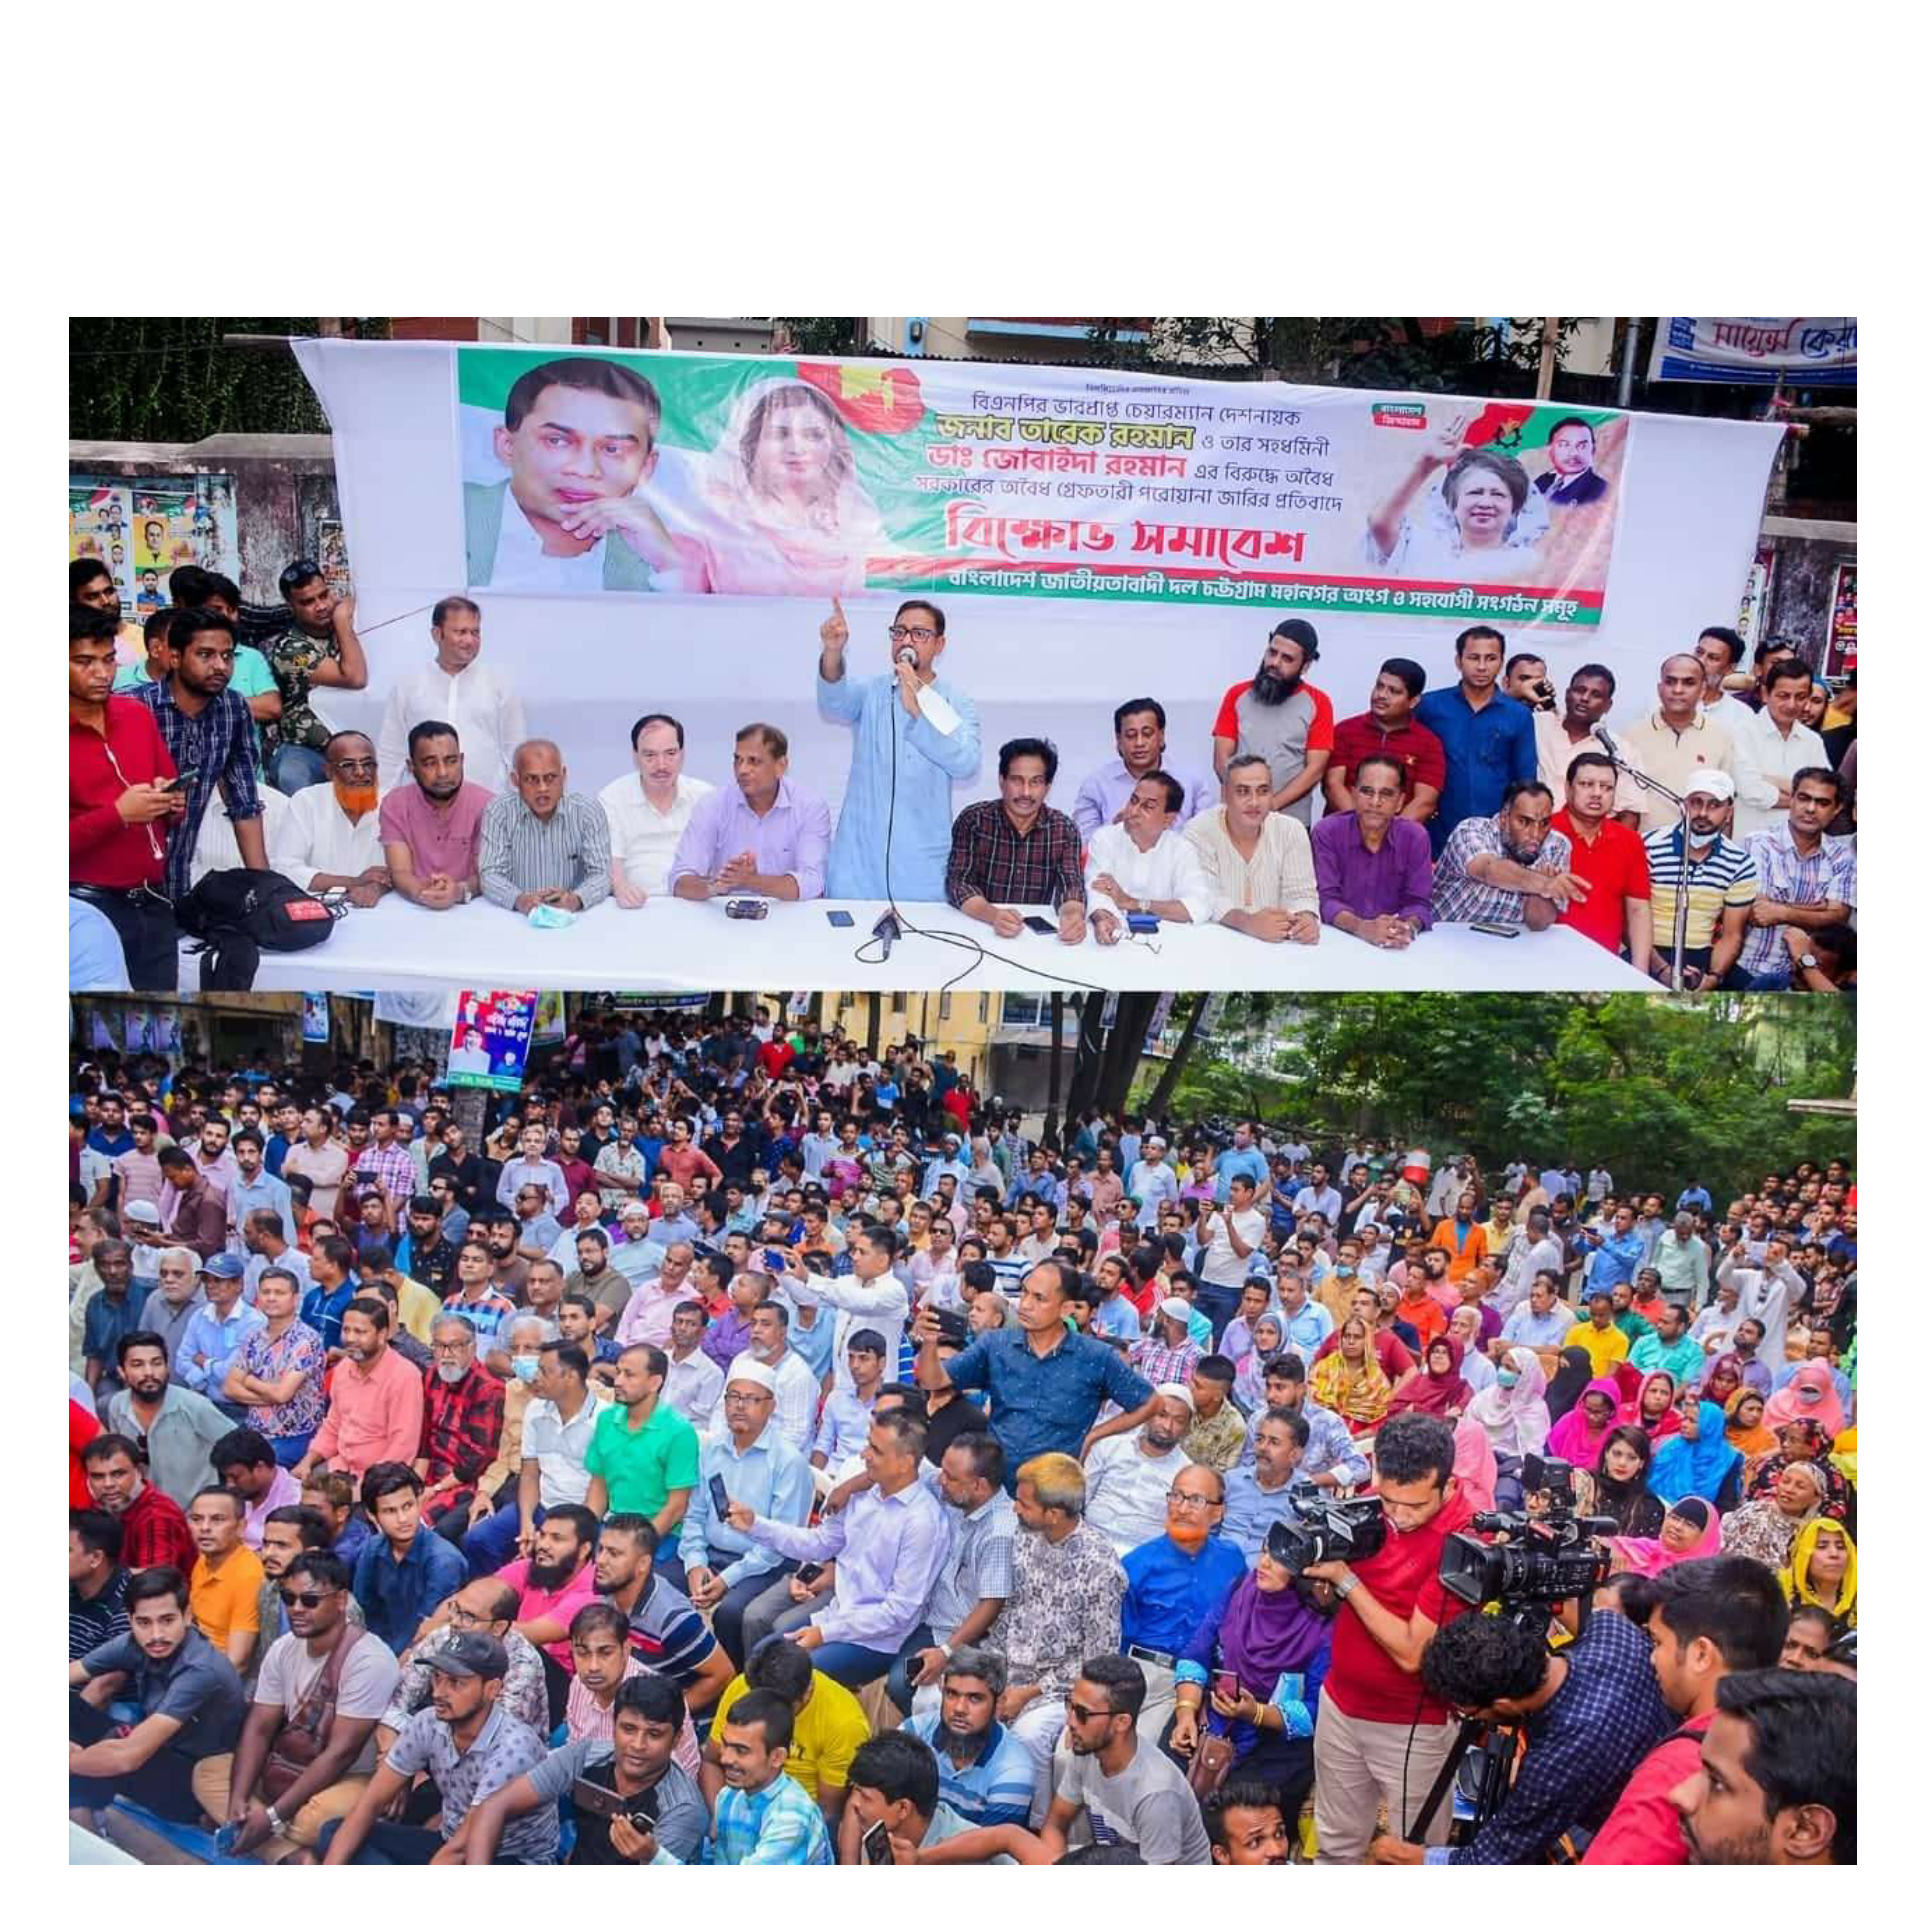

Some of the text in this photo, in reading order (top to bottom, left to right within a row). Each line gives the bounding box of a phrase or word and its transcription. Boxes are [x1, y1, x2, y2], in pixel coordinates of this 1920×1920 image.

[972, 391, 1302, 426] বিএনপির ভারপ্রাপ্ত চেয়ারম্যান দেশনায়ক
[937, 415, 1014, 441] জনাব
[1018, 417, 1107, 445] তারেক
[1109, 423, 1196, 450] রহমান
[1201, 435, 1215, 450] ও
[984, 446, 1097, 474] জোবাইদা
[1104, 454, 1187, 478] রহমান
[1194, 464, 1220, 480] এর
[1224, 461, 1281, 484] বিরুদ্ধে
[1286, 469, 1334, 487] অবৈধ
[916, 476, 995, 495] সরকারের
[1000, 478, 1052, 497] অবৈধ
[1138, 487, 1211, 505] পরোয়ানা
[1217, 489, 1271, 508] জারির
[1275, 490, 1343, 512] প্রতিবাদে
[947, 502, 1309, 567] বিক্ষোভ সমাবেশ
[949, 568, 1578, 621] বাংলাদেশ জাতীয়তাবাদী দল চট্টগ্রাম মহানগর অংগ ও সহযোগী সংগঠন সমূহ
